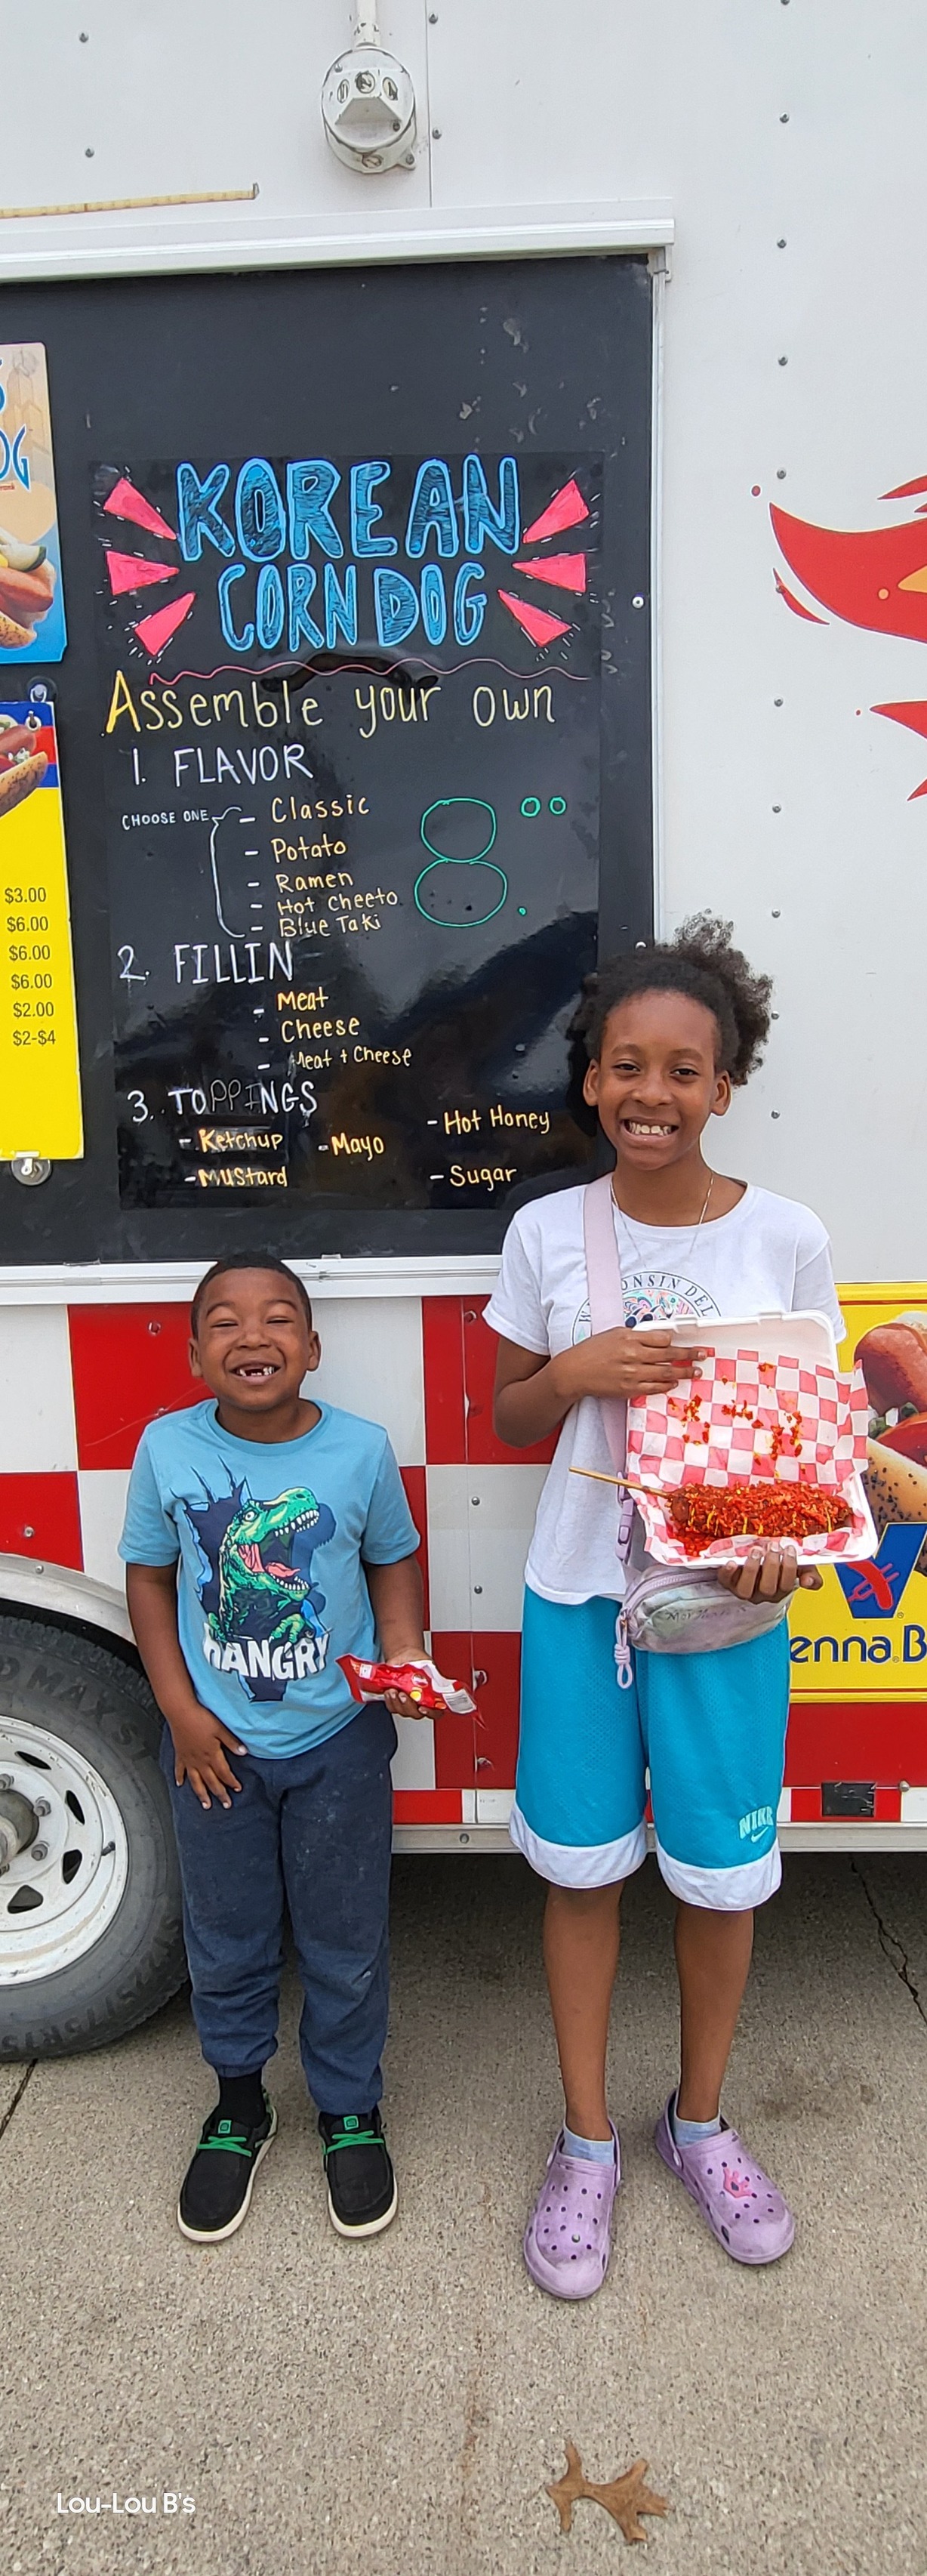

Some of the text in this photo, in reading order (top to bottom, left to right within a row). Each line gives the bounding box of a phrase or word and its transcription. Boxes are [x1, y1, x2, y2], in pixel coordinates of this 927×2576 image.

[175, 454, 522, 565] KOREAN
[217, 560, 488, 652] CORN DOG
[104, 668, 556, 739] Assemble your own
[173, 743, 314, 788] FLAVOR
[122, 809, 210, 831] CHOOSE ONE
[271, 793, 371, 823] Classic
[270, 832, 347, 863] Potato
[5, 887, 47, 904] $3.00
[275, 872, 354, 894] Ramen
[276, 896, 316, 916] Hot
[7, 916, 49, 933] $6.00
[279, 912, 382, 938] Blue Taki
[9, 945, 51, 961] $6.00
[117, 939, 294, 986] 2. FILLIN
[11, 973, 53, 991] $6.00
[13, 1001, 54, 1019] $2.00
[276, 986, 329, 1011] Meat
[12, 1029, 56, 1047] $2-$4
[281, 1017, 361, 1044] Cheese
[353, 1044, 413, 1067] Cheese
[168, 1079, 318, 1116] TOPPINGS
[199, 1103, 550, 1162] Ketchup Mayo Hot Honey
[449, 1165, 518, 1192] Sugar
[26, 1664, 118, 1726] MAX
